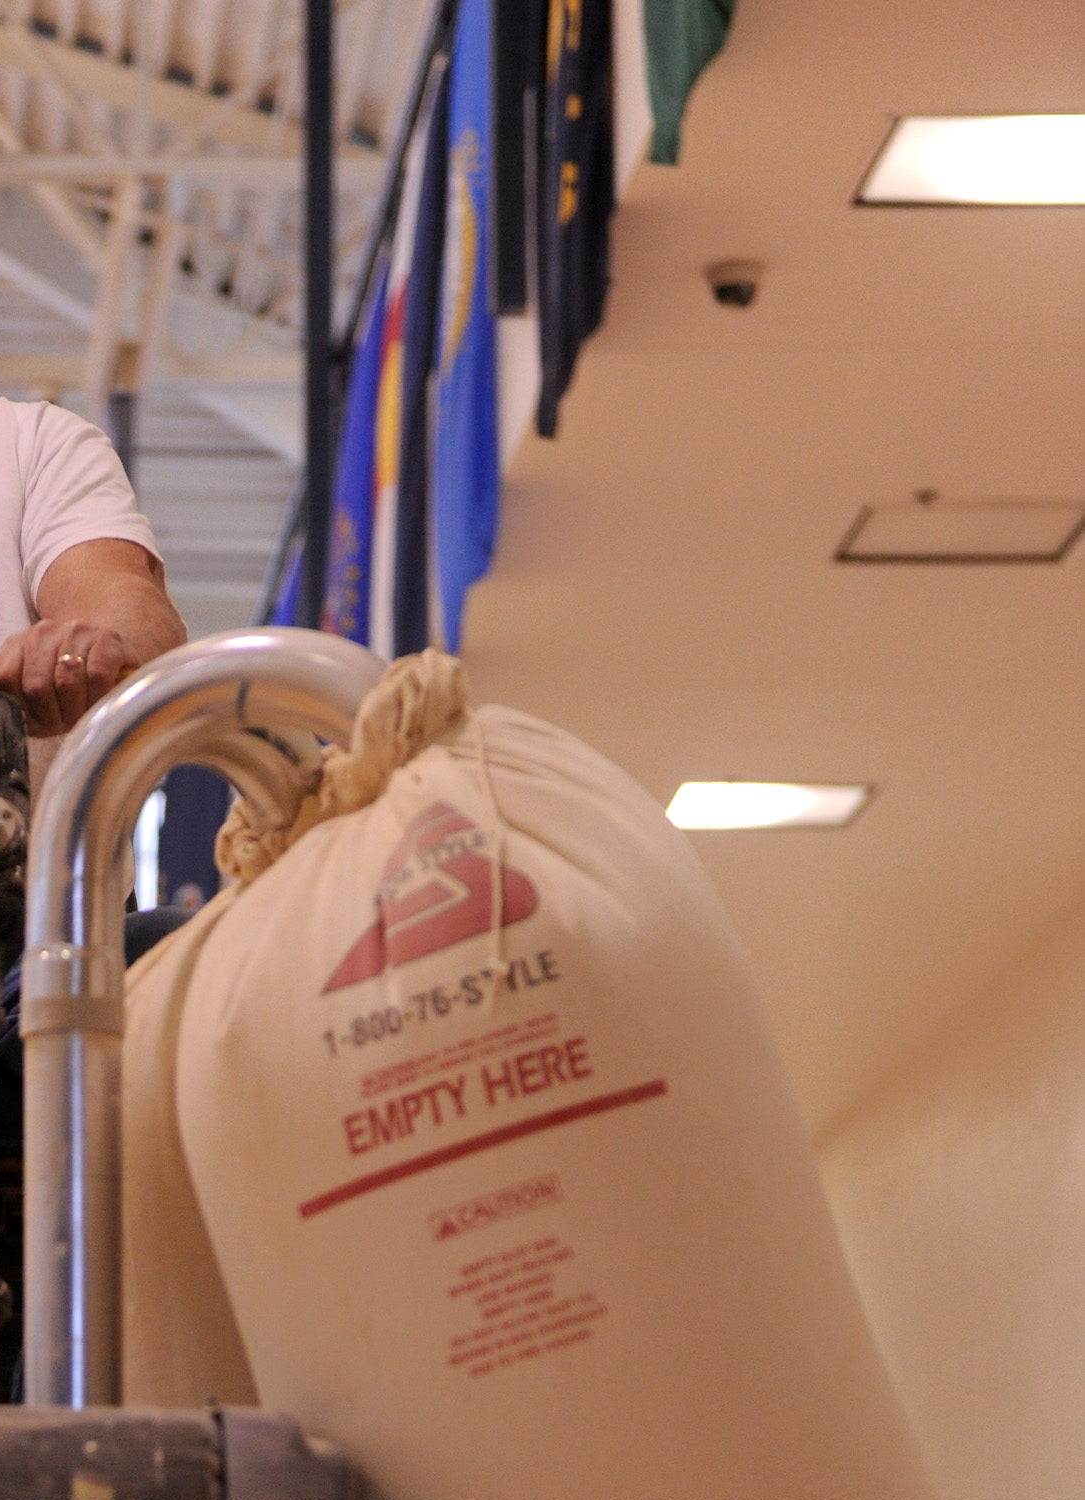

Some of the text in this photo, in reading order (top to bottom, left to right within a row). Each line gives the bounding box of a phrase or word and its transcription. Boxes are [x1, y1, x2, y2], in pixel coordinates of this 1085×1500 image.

[343, 1074, 467, 1155] EMPTY
[480, 1035, 594, 1107] HERE
[457, 1176, 557, 1231] CAUTION
